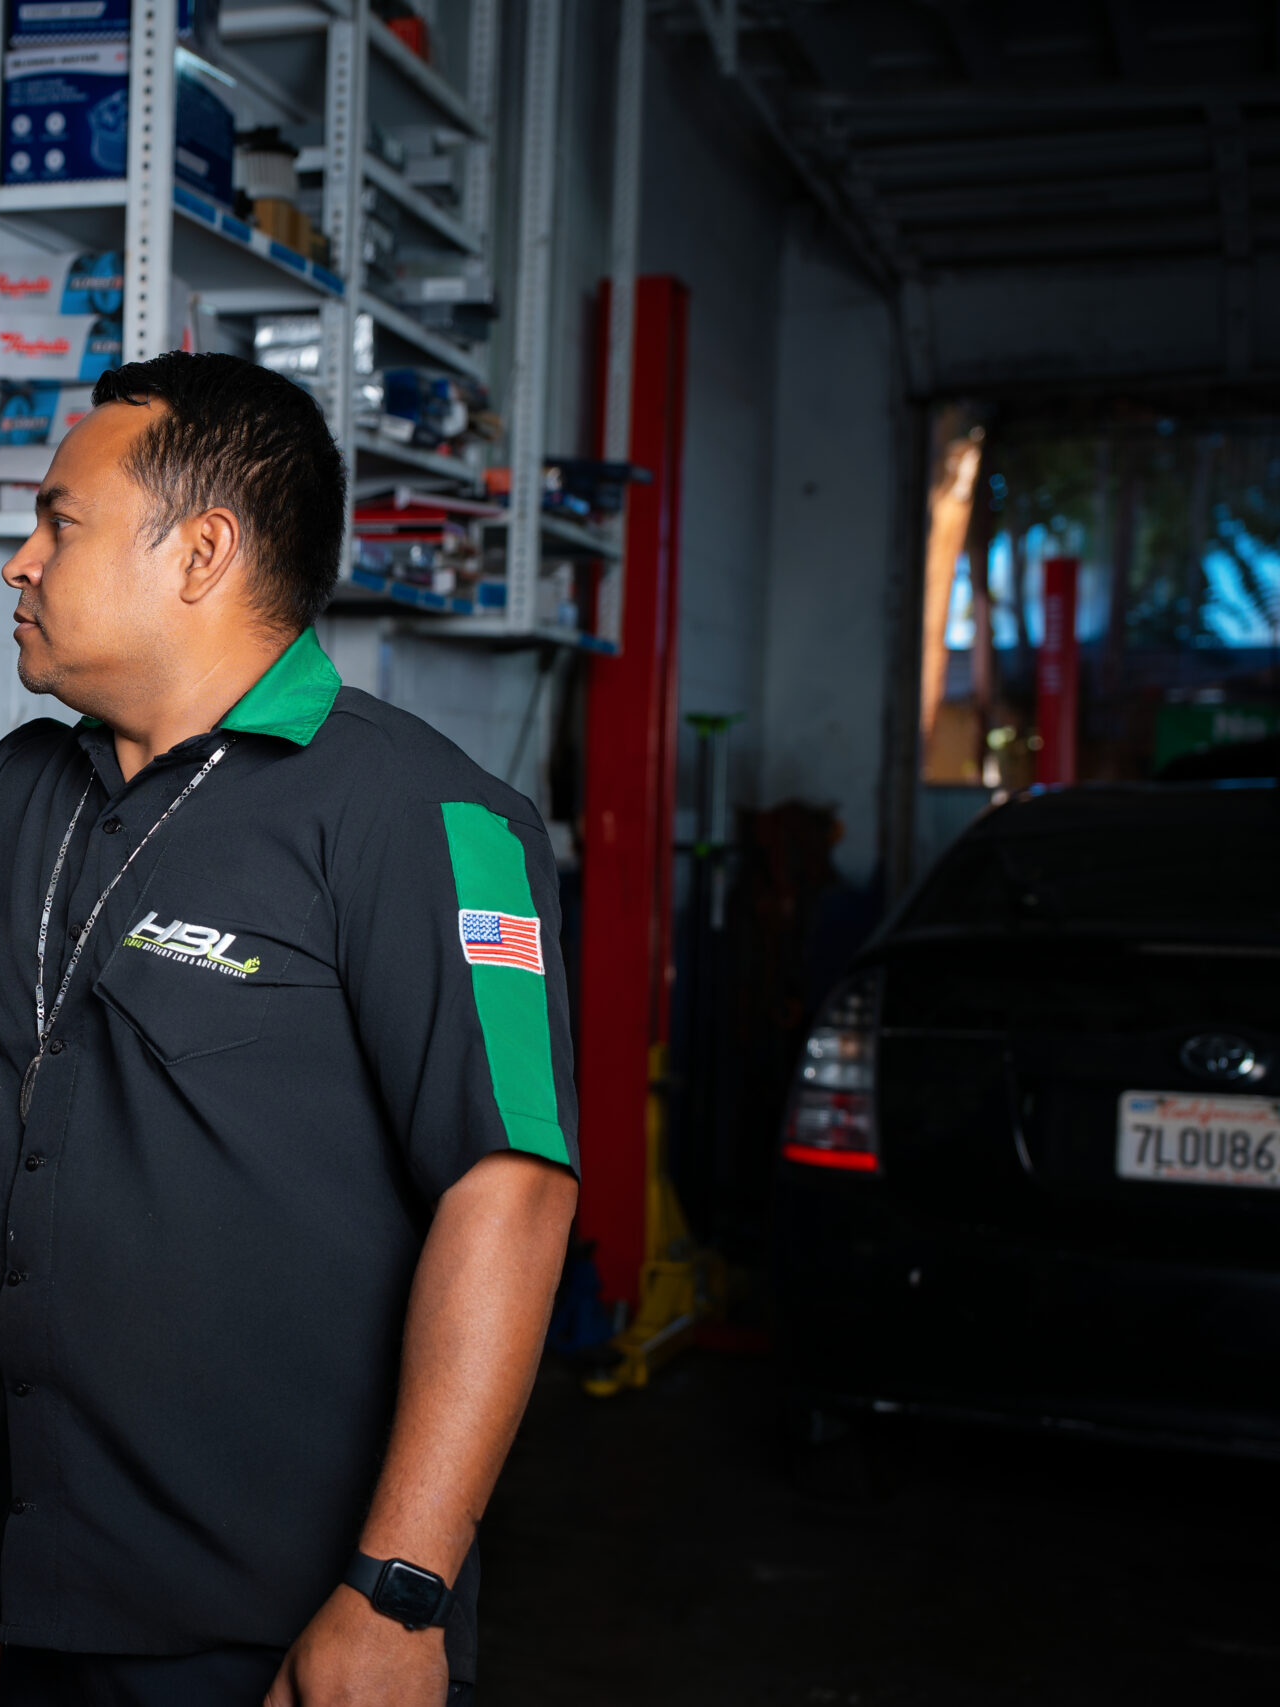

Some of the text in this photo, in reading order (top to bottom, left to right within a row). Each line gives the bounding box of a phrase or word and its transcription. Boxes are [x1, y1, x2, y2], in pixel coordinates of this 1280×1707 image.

[128, 911, 244, 968] HBL
[142, 942, 173, 958] BATTERY
[173, 952, 189, 963] LAB
[196, 958, 218, 970] AUTO
[219, 965, 247, 979] REPAIR
